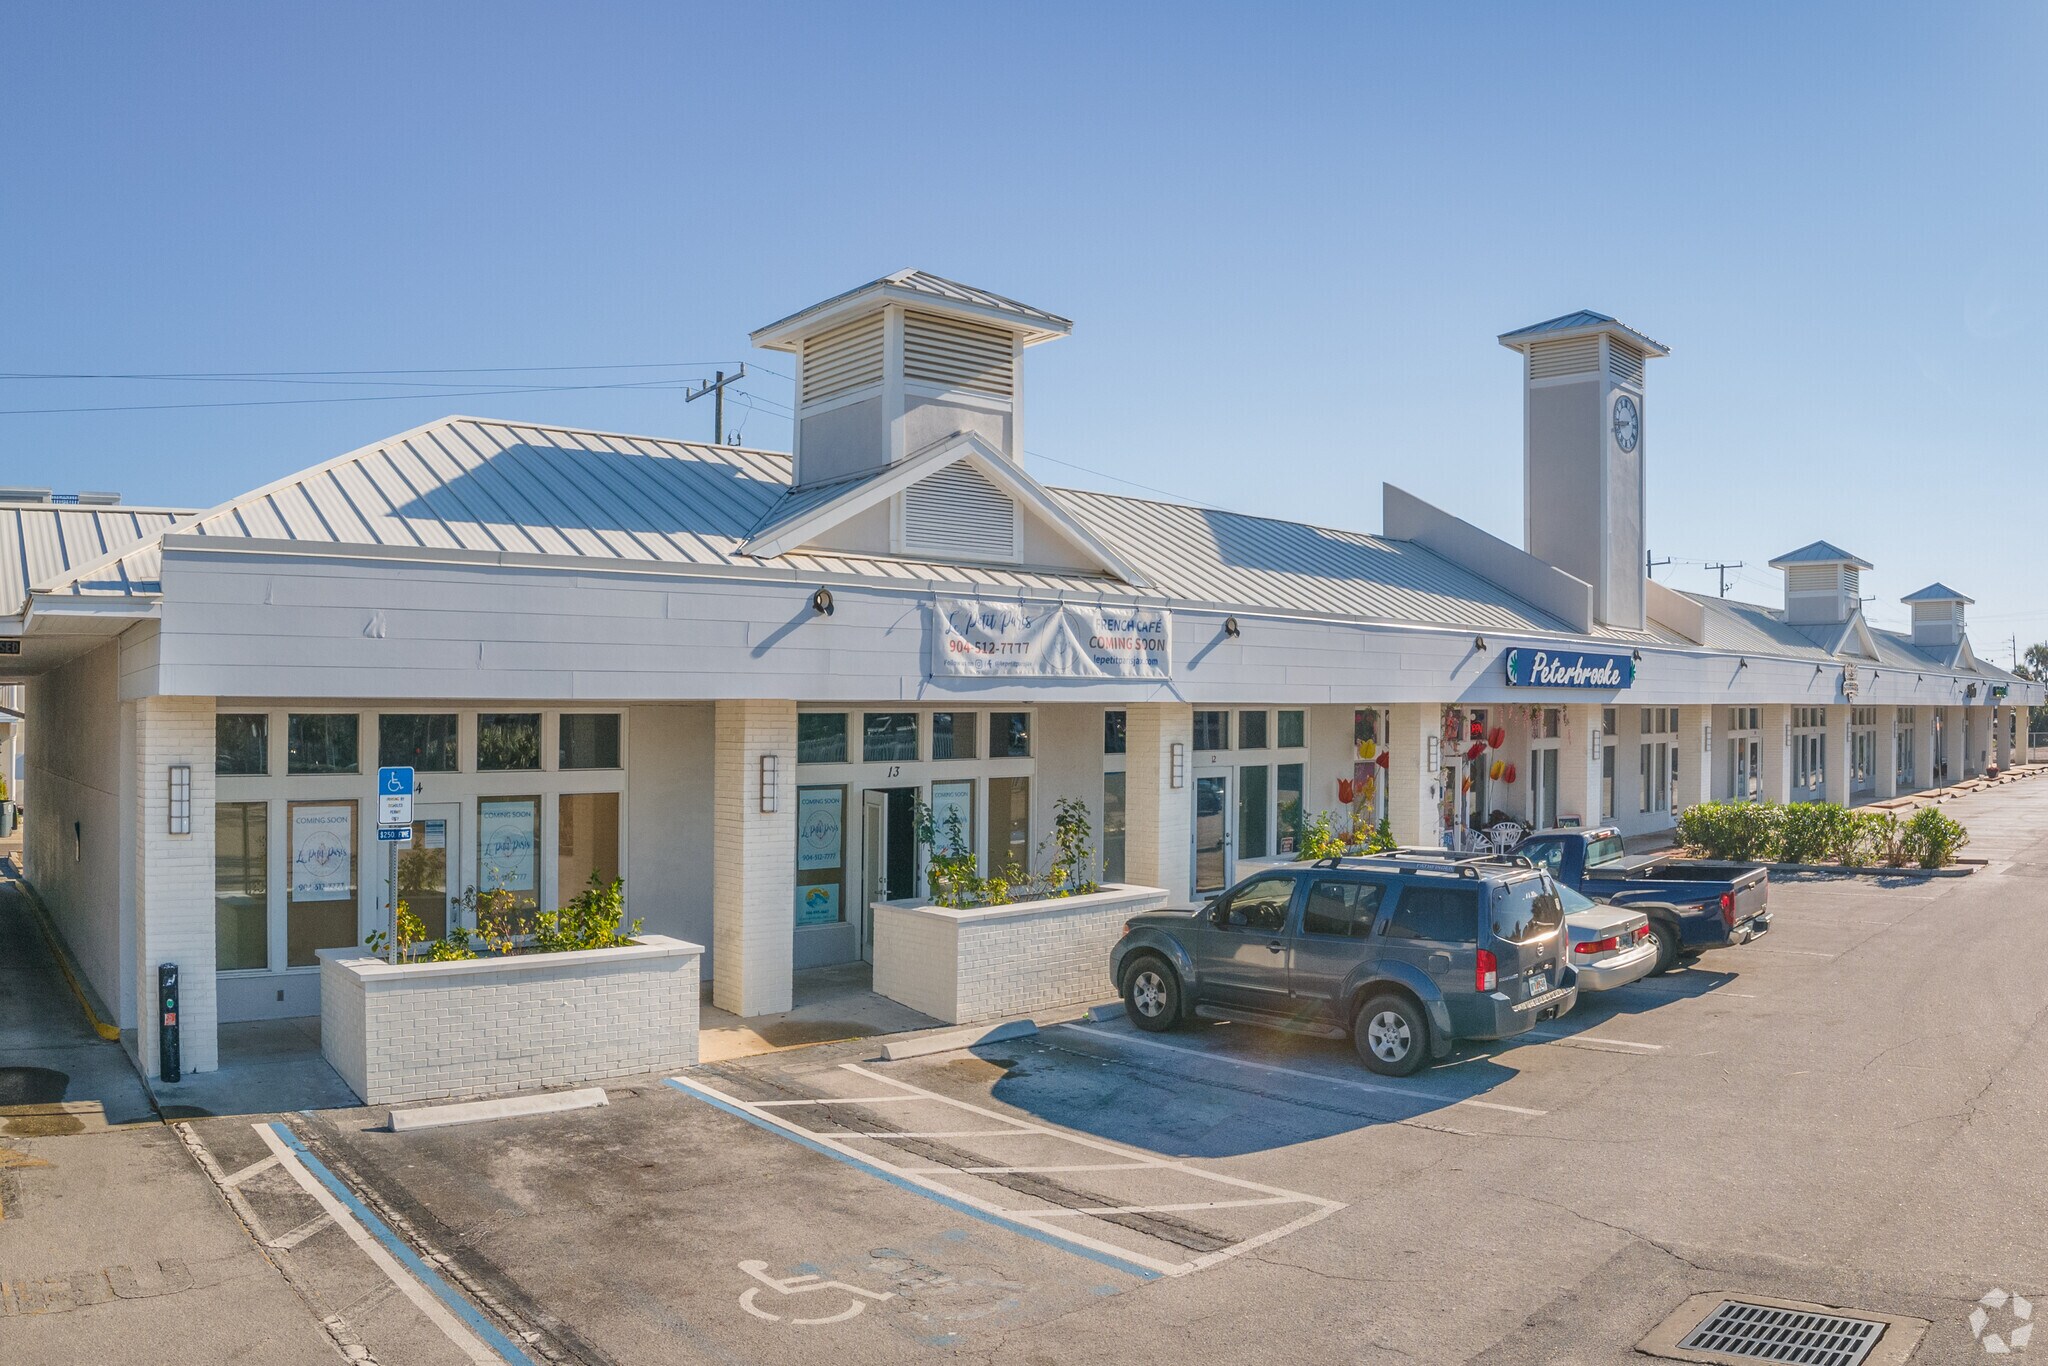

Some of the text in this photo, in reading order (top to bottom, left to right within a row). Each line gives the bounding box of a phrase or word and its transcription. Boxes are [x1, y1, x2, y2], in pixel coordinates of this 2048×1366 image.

[945, 611, 1032, 635] Le Petit Paris
[1096, 619, 1162, 633] FRENCH CAFÉ
[949, 640, 1030, 655] 904-512-7777
[1089, 636, 1166, 652] COMING SOON
[1530, 651, 1620, 685] Peterbrooke
[887, 766, 900, 778] 13
[414, 782, 423, 794] 4
[326, 816, 348, 824] SOON
[484, 811, 511, 819] COMING
[380, 831, 395, 839] $250
[802, 853, 837, 861] 904-512-7777
